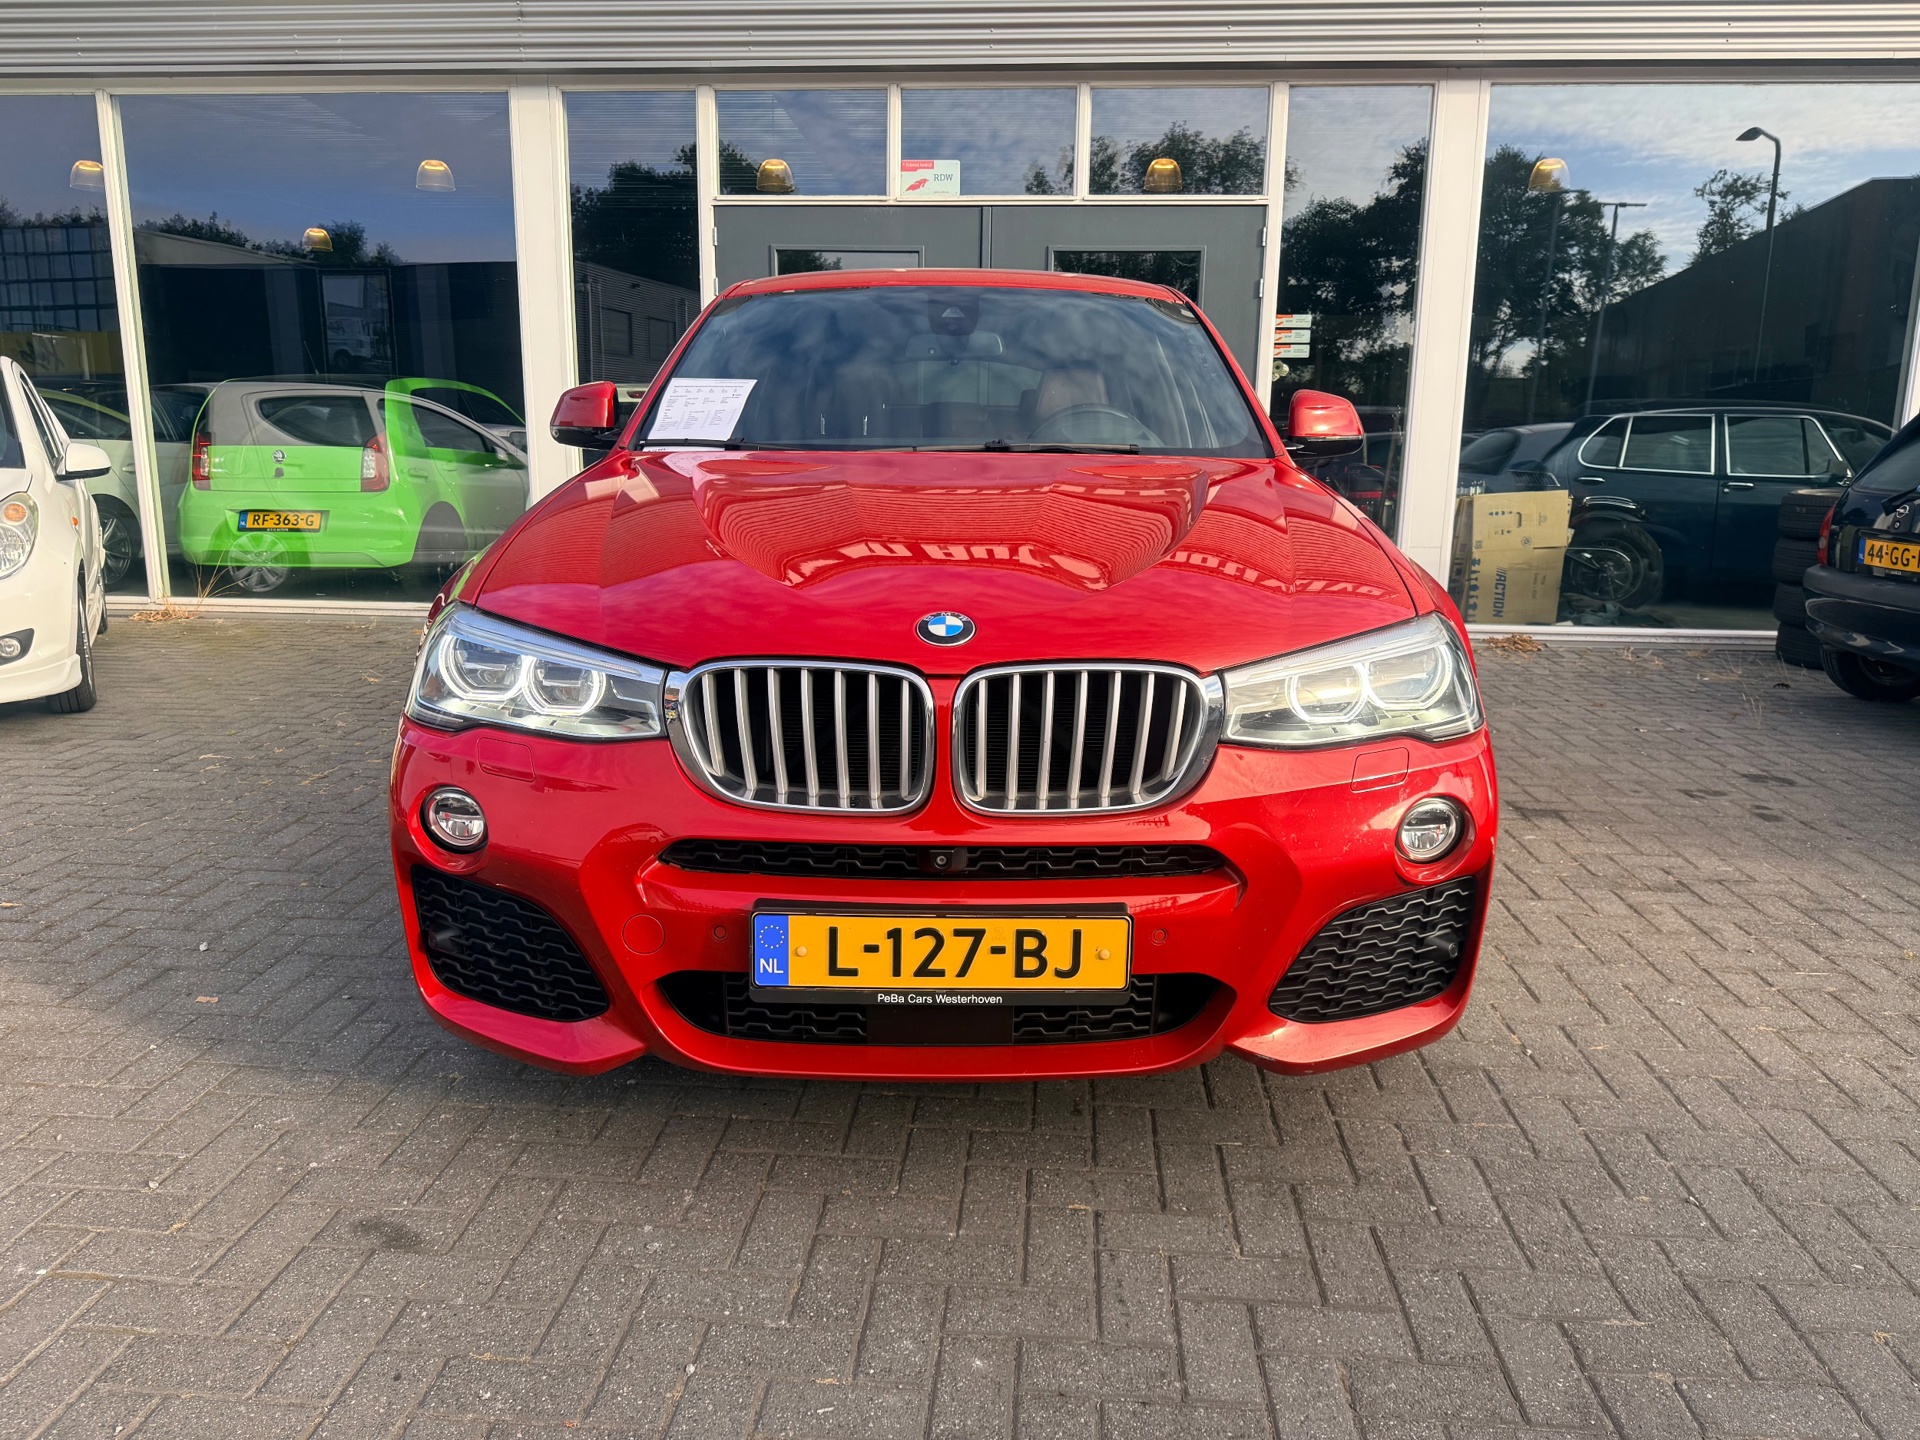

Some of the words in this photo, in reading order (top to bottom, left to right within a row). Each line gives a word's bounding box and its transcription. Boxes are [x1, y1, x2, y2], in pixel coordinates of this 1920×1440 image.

[933, 173, 954, 182] RDW
[252, 514, 314, 526] RF-363-G
[1867, 543, 1920, 569] 44-GG-
[1492, 573, 1507, 618] ACTION
[827, 926, 1083, 979] L-127-BJ
[759, 957, 784, 974] NL
[877, 993, 905, 1003] PeBa
[907, 993, 933, 1004] Cars
[935, 994, 1003, 1004] Westerhoven
